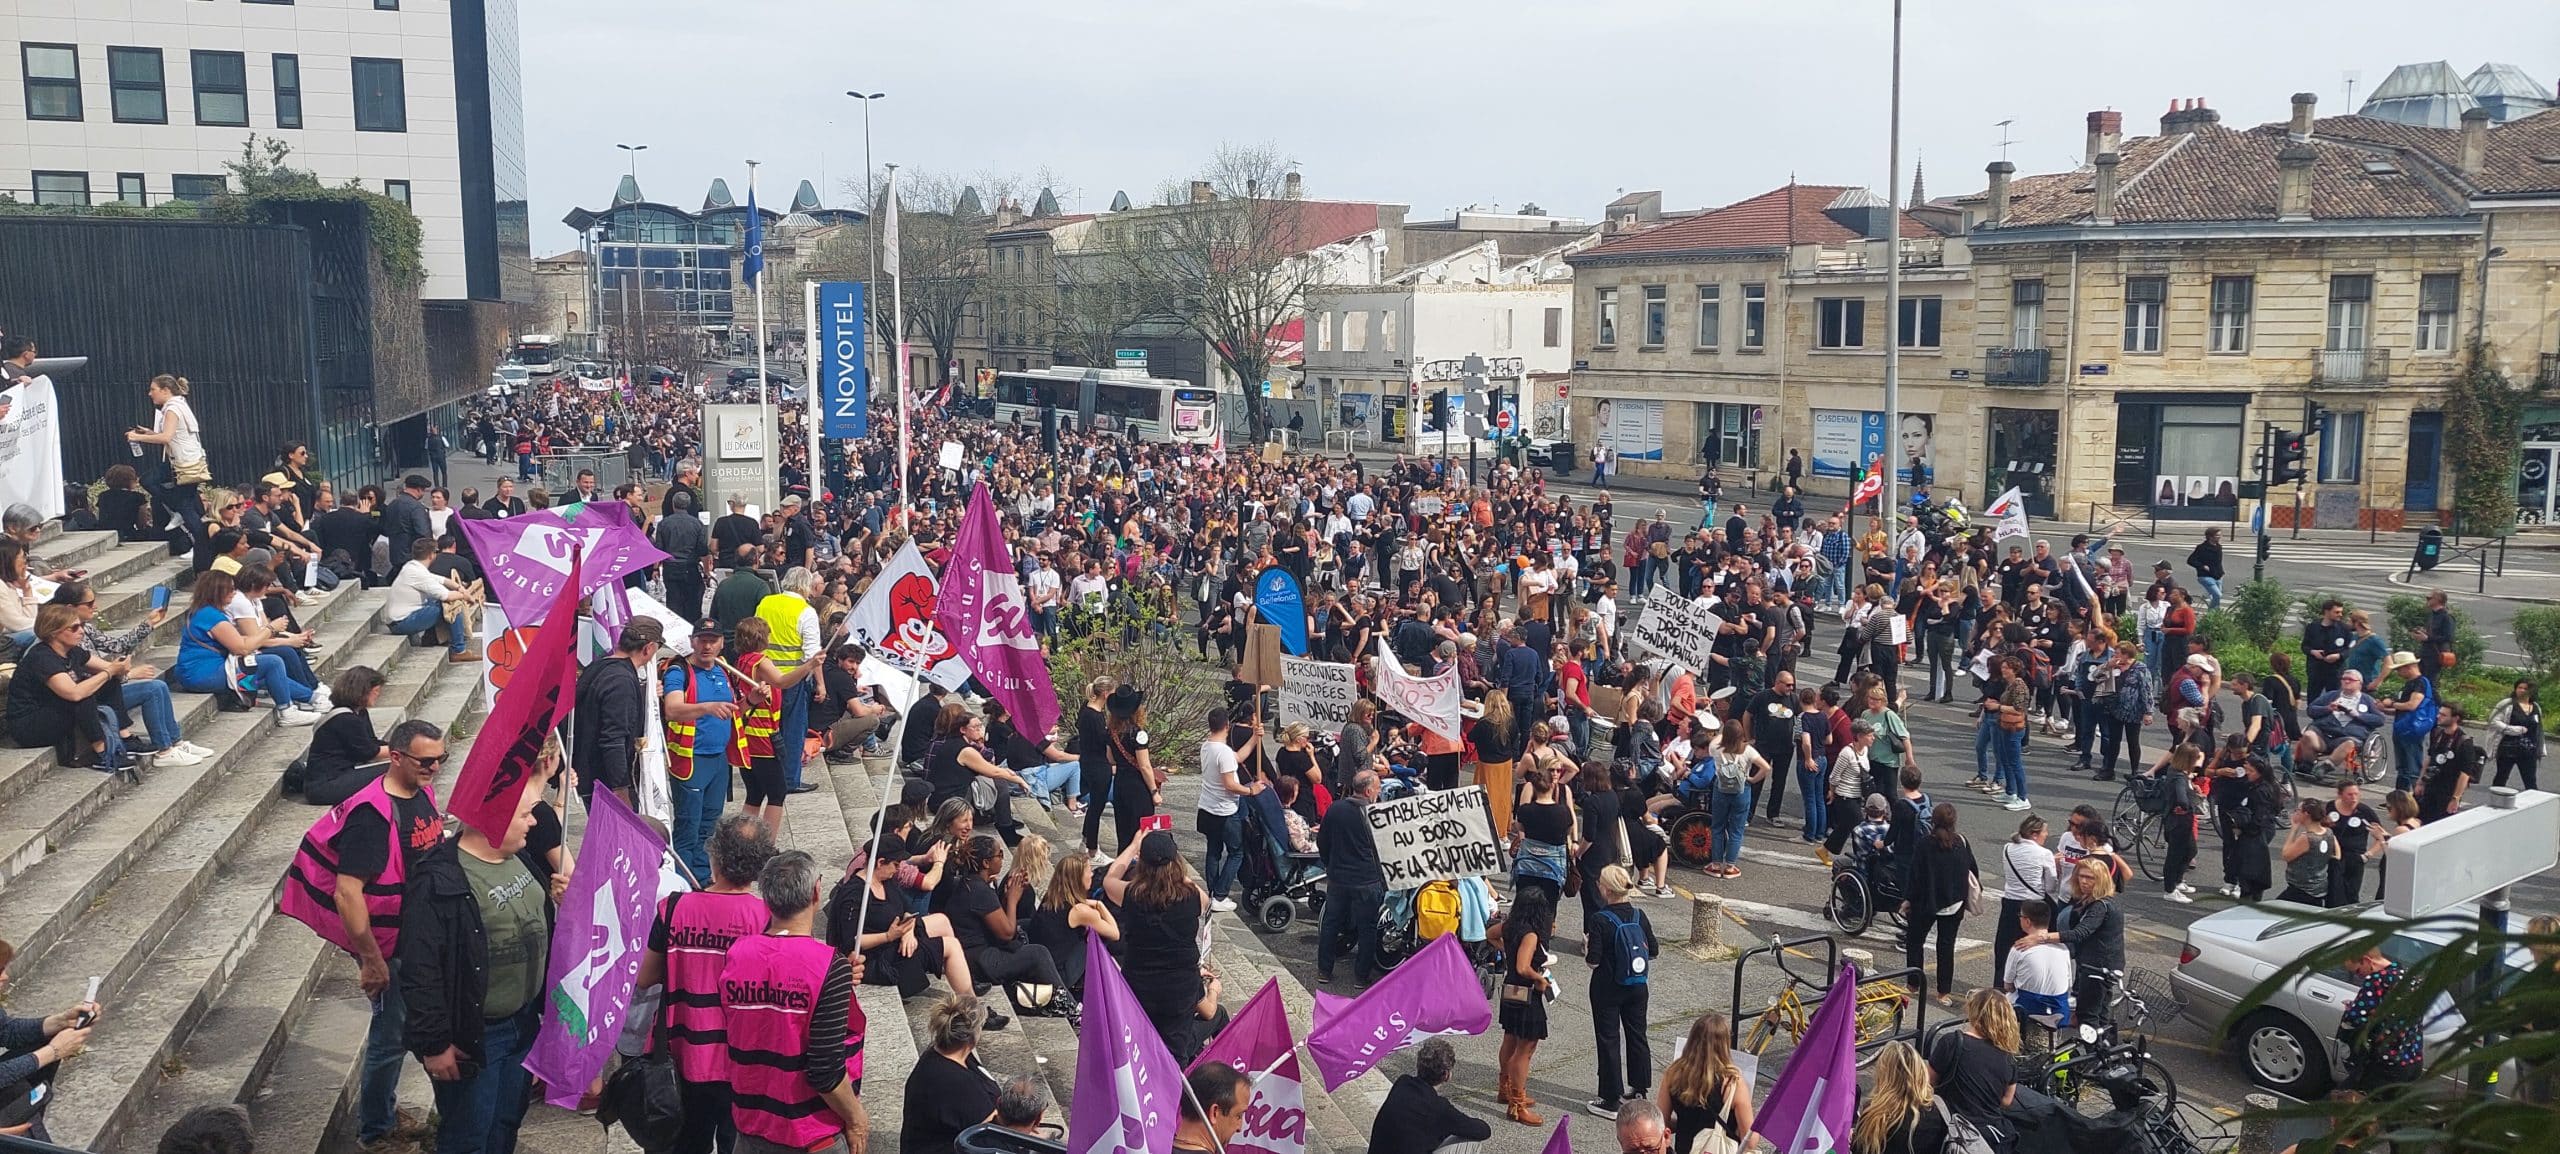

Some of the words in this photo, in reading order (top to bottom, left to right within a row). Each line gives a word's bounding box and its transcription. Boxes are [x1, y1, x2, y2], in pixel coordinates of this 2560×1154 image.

[833, 292, 856, 417] NOVOTEL
[711, 467, 762, 477] BORDEAU
[492, 553, 554, 598] Santé
[583, 545, 631, 596] ociaux
[960, 556, 982, 637] Santé
[1665, 591, 1690, 614] POUR
[1693, 606, 1706, 622] LA
[1636, 624, 1705, 670] FONDAMENTAUX
[1656, 616, 1699, 651] DROITS
[1698, 625, 1714, 642] NOS
[1286, 661, 1347, 682] PERSONNES
[1287, 702, 1301, 716] EN
[1393, 830, 1415, 848] AU
[1419, 818, 1467, 843] BORD
[1381, 859, 1405, 882] DE
[1407, 855, 1427, 878] LA
[1421, 841, 1497, 874] RUPTURE
[666, 925, 738, 949] Solidair
[725, 979, 811, 1009] Solidaires
